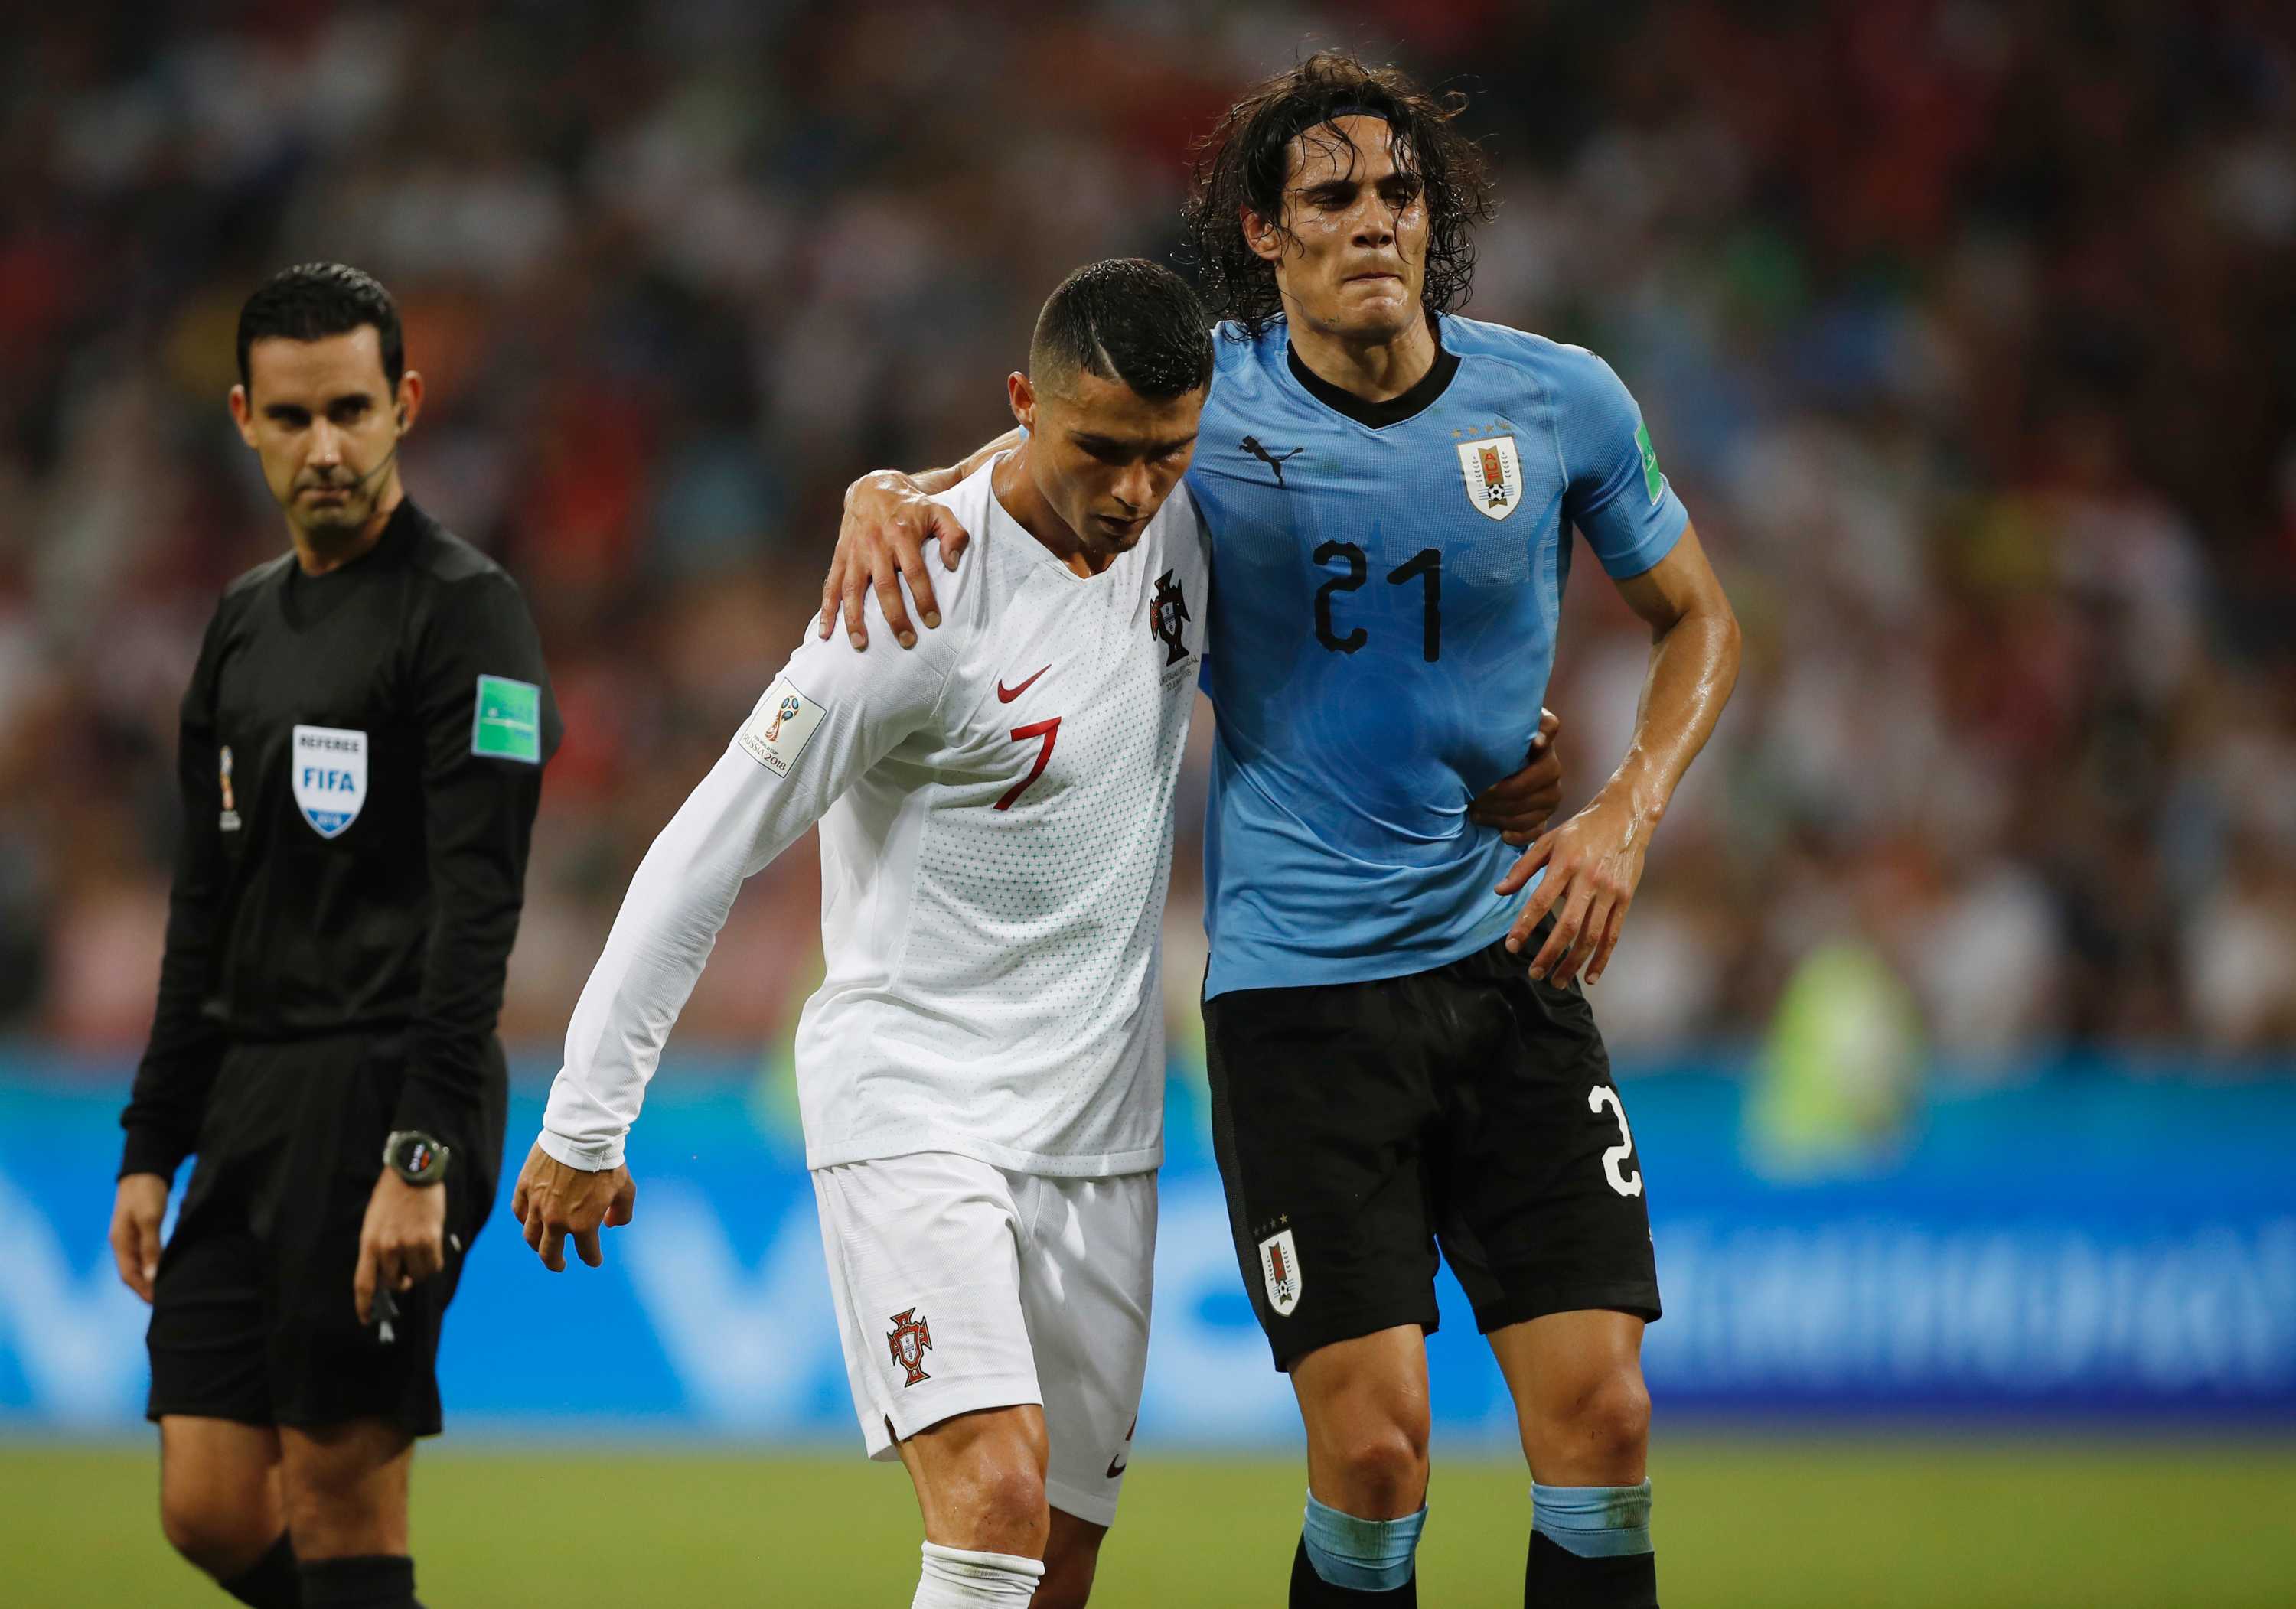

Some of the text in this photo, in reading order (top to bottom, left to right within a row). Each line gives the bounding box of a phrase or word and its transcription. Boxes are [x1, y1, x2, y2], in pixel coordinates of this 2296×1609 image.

[1313, 539, 1441, 663] 21
[303, 767, 354, 792] FIFA
[743, 734, 764, 757] RUSSIA
[764, 753, 786, 770] 2018
[993, 715, 1062, 812] 7
